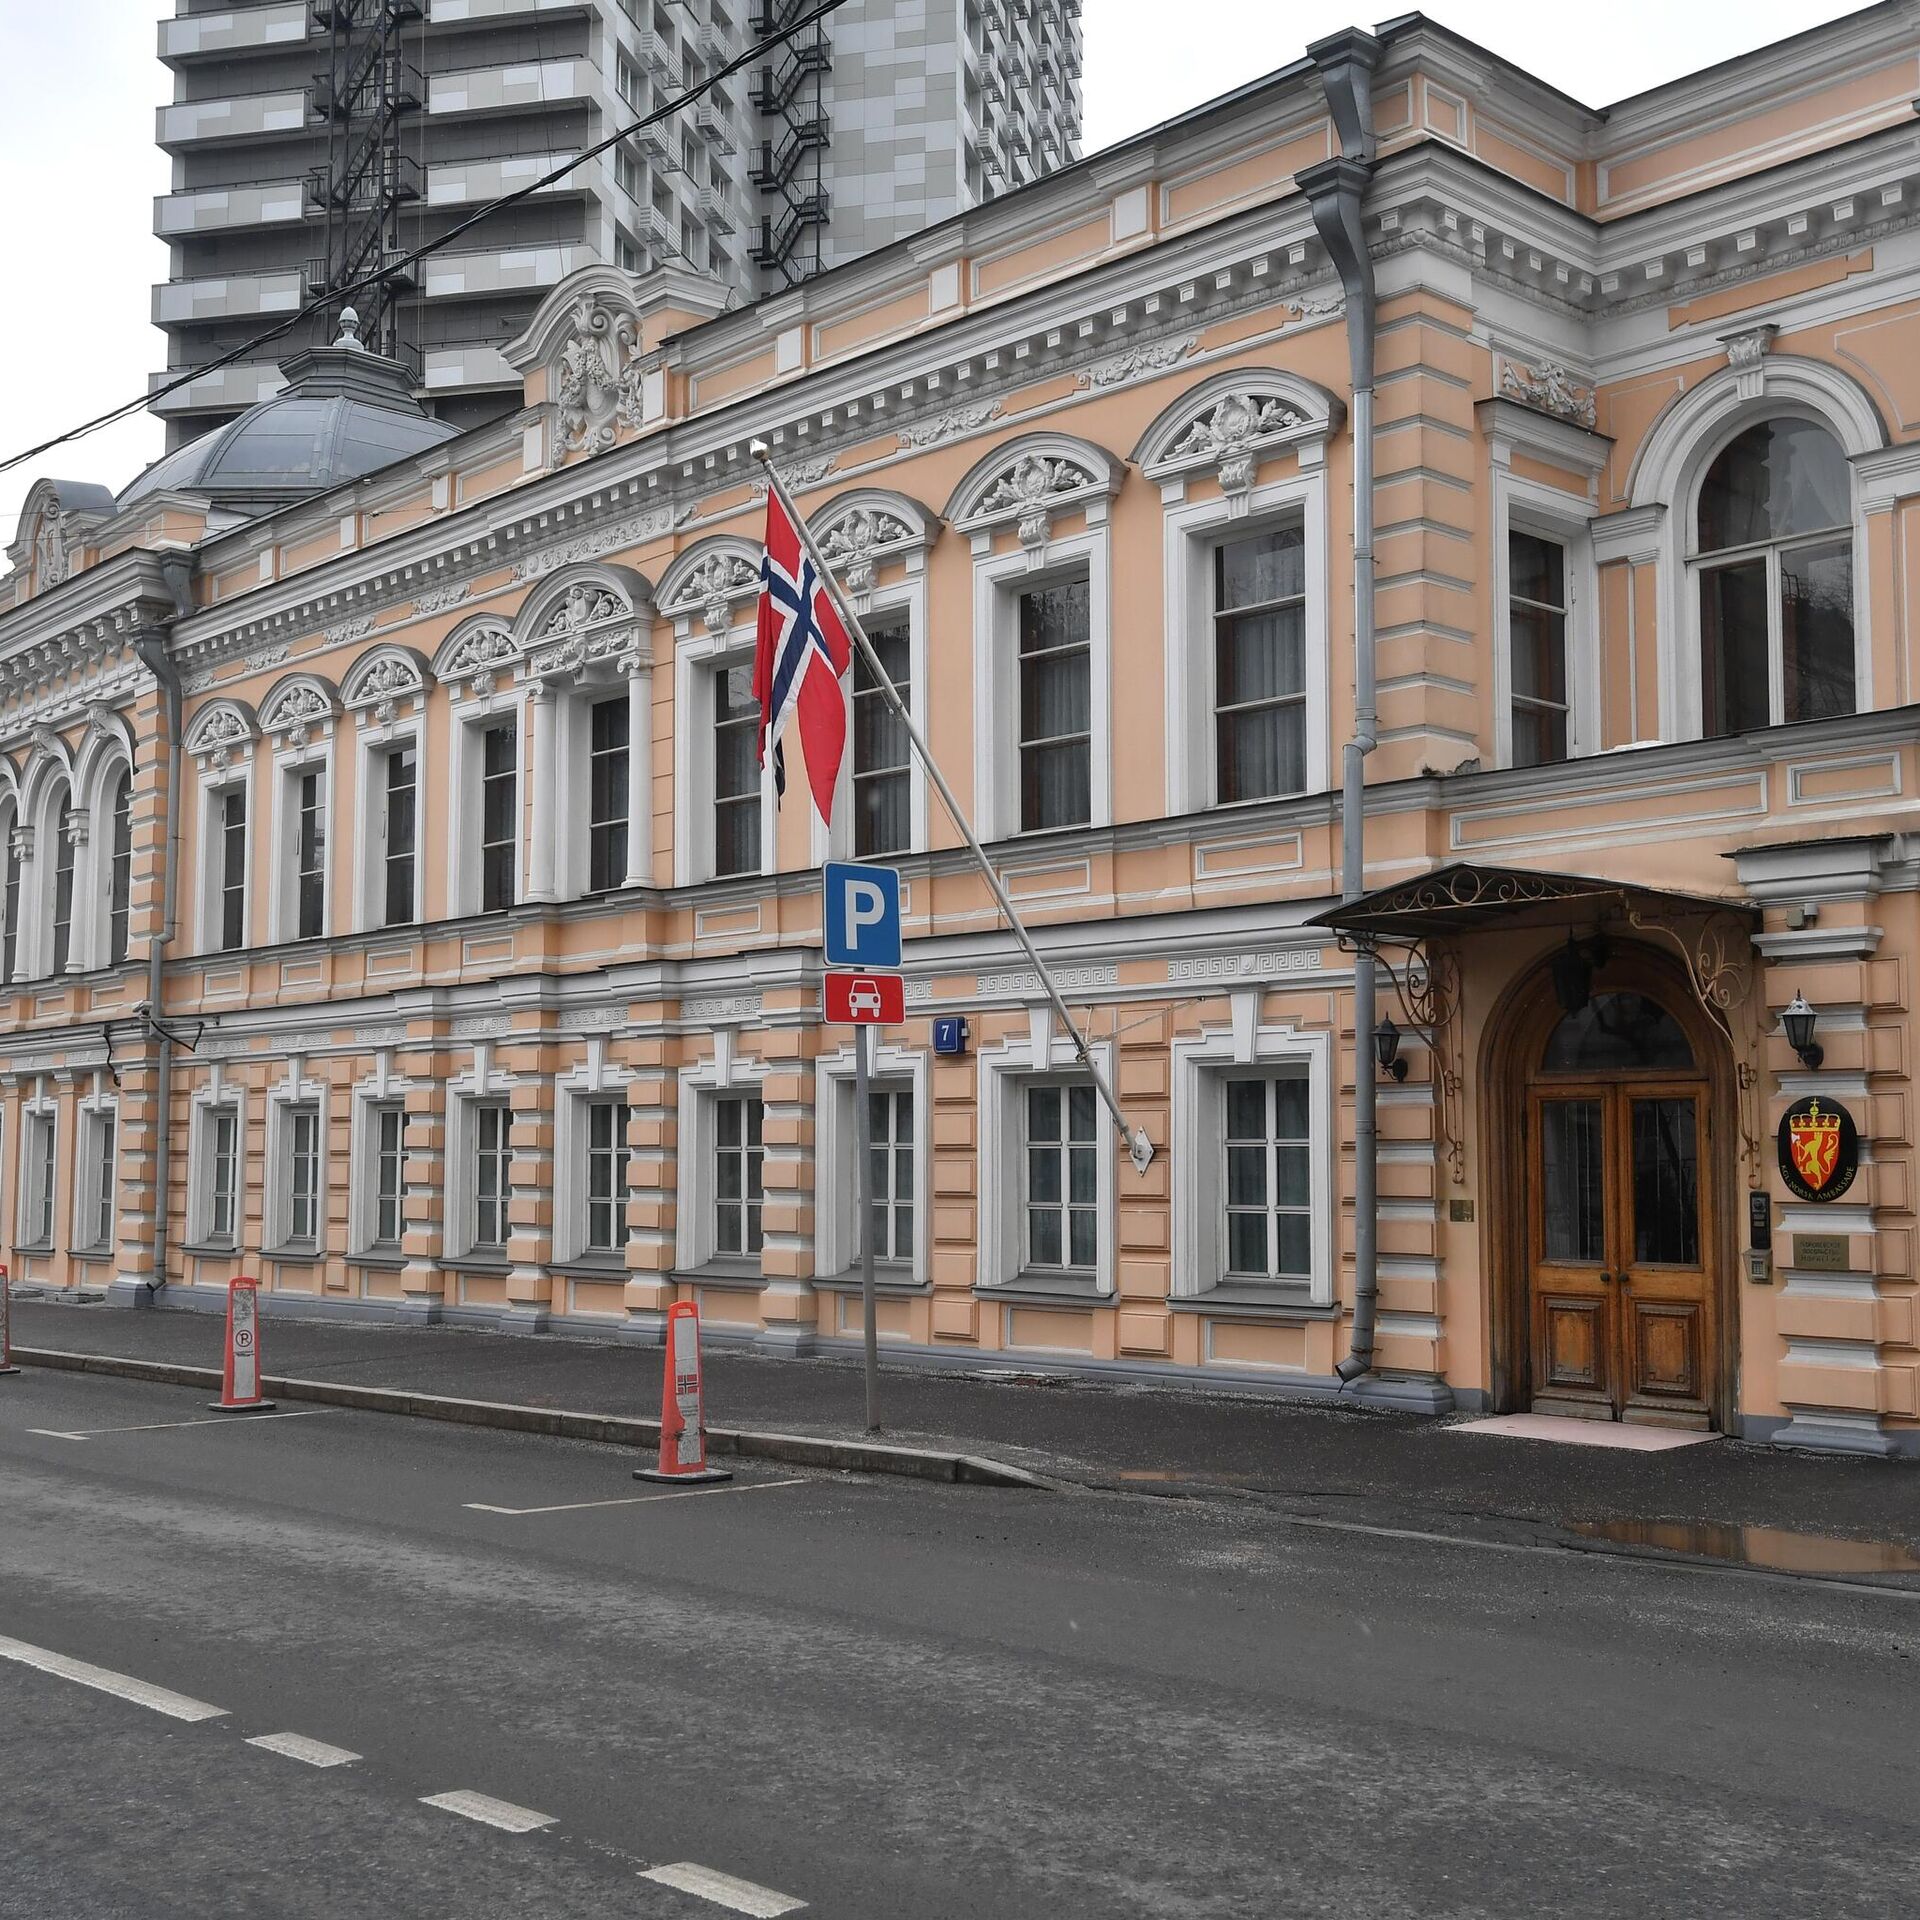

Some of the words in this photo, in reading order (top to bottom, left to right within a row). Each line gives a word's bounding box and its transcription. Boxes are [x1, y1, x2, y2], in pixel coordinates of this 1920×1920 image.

[844, 879, 886, 950] P
[941, 1024, 950, 1041] 7
[1788, 1180, 1814, 1200] NORSK
